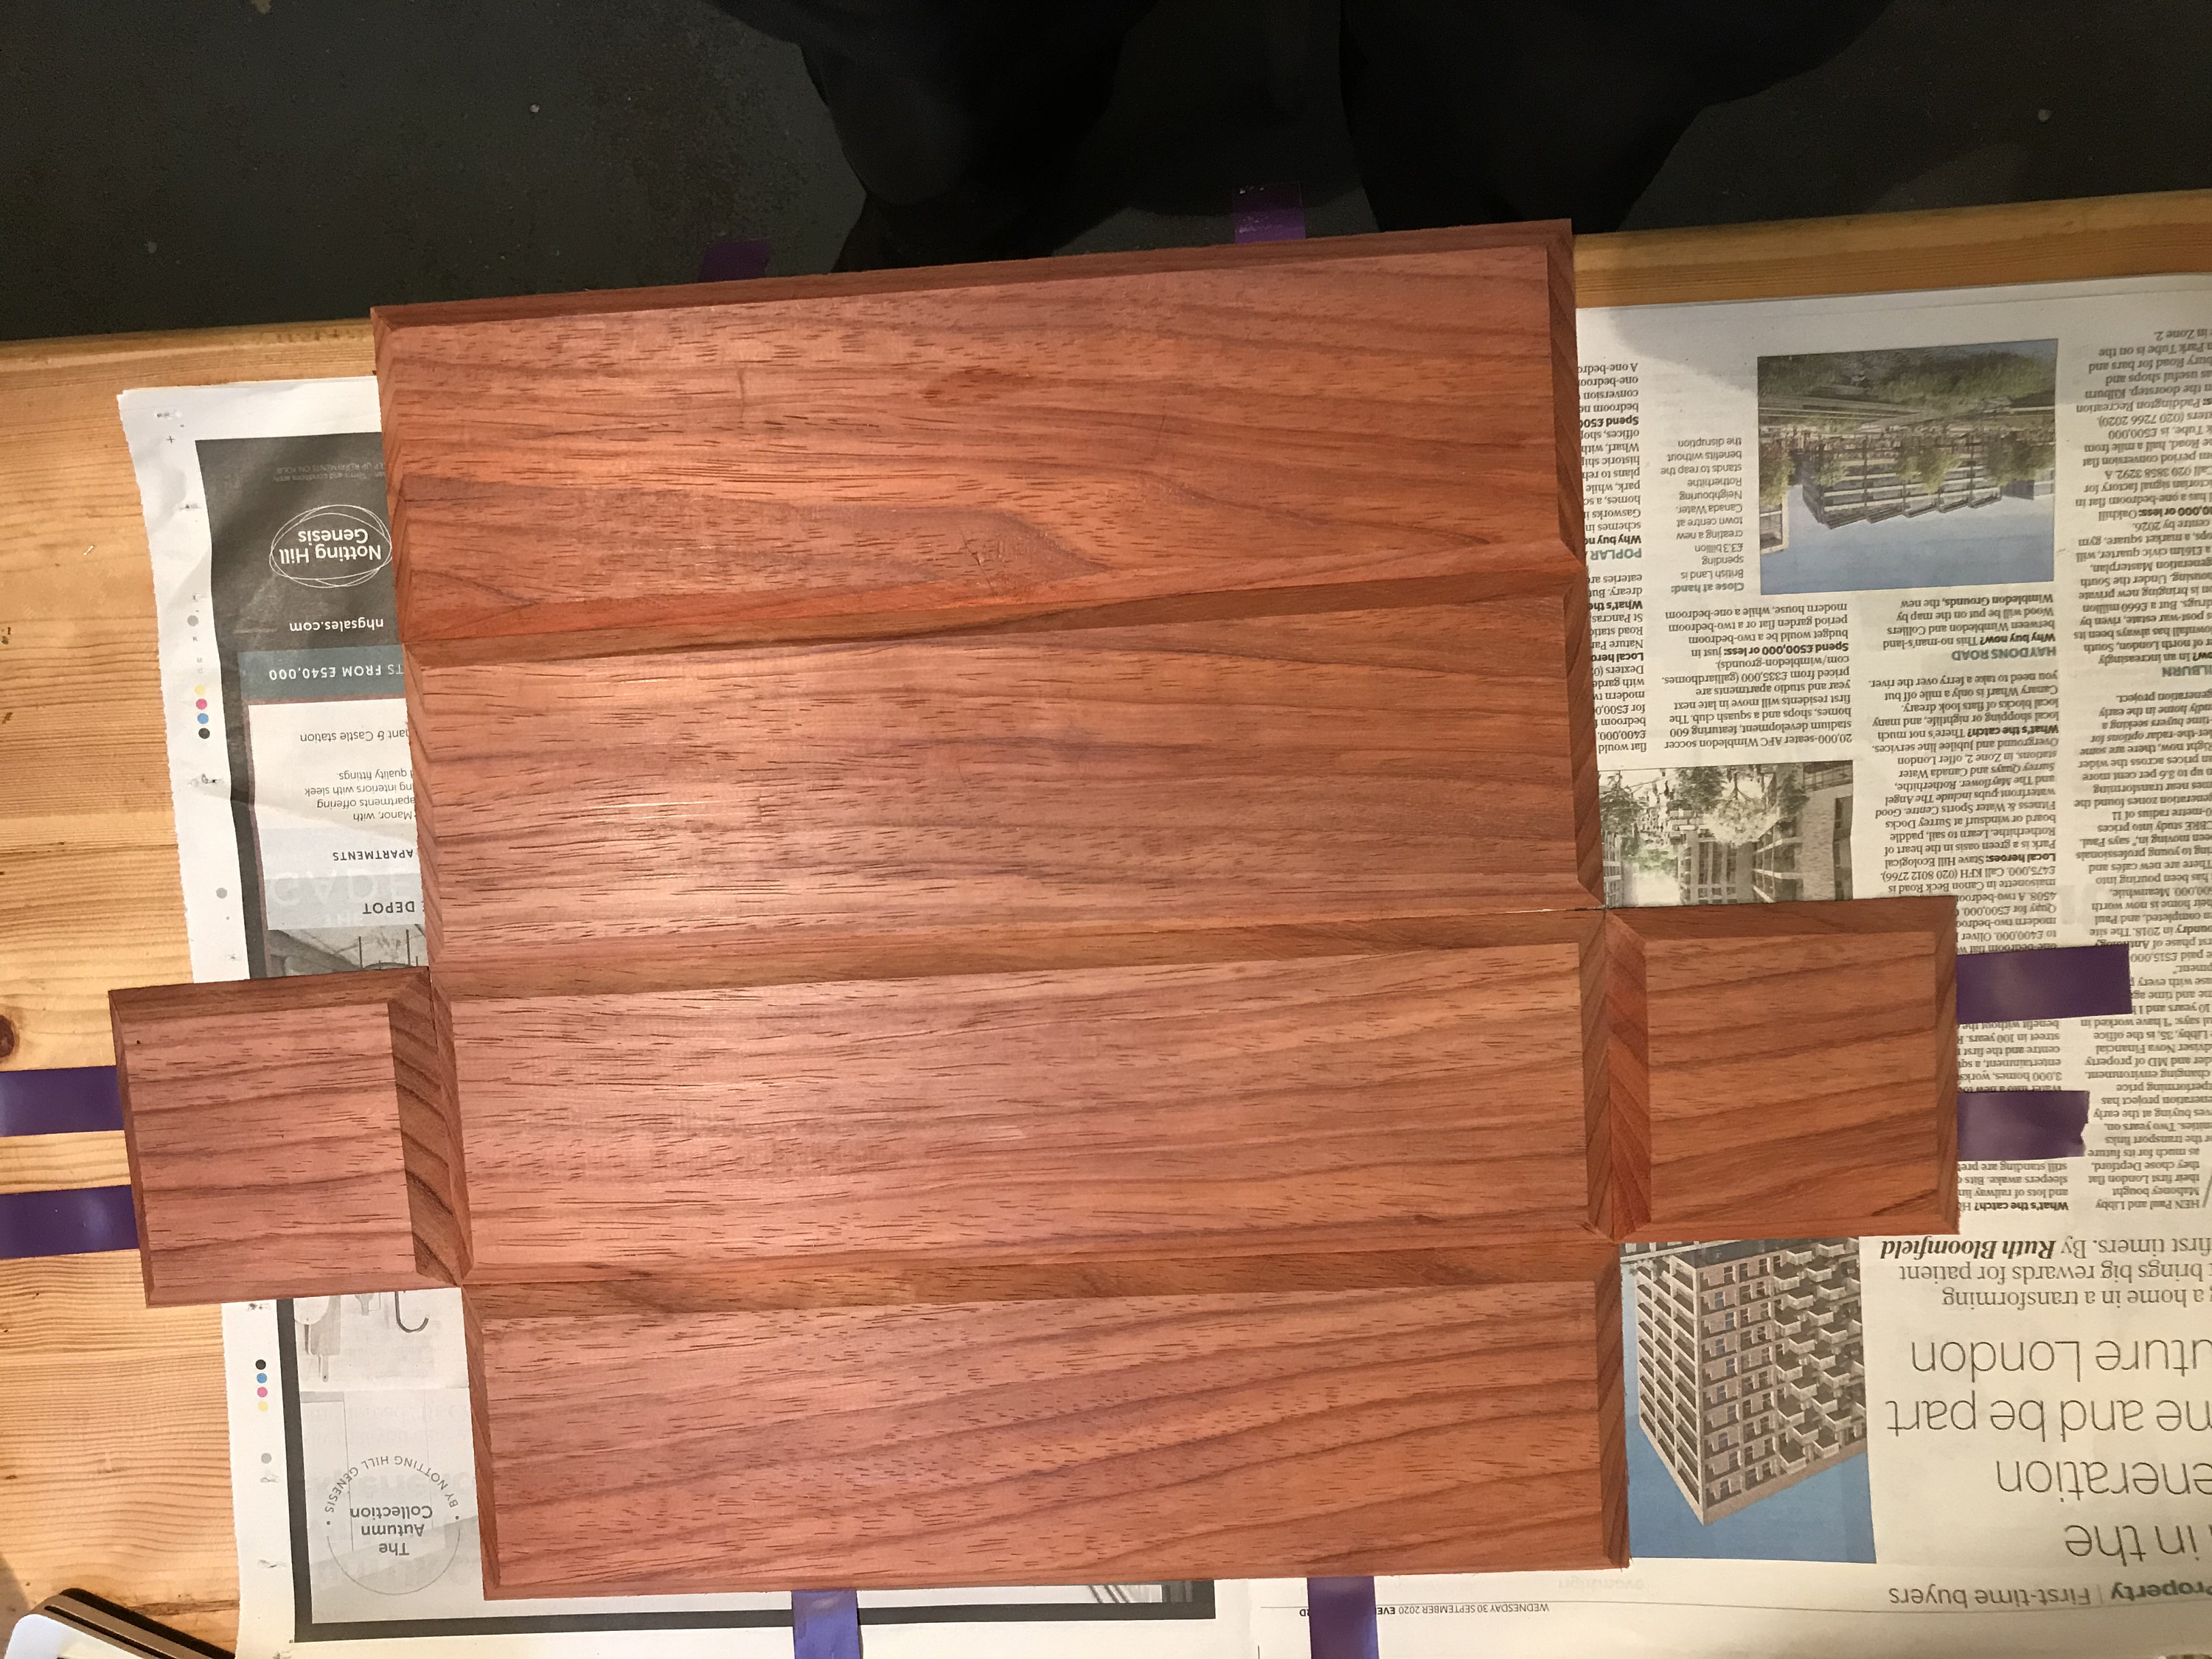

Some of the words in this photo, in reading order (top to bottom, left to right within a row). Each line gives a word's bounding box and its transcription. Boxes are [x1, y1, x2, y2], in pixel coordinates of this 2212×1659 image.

[1677, 438, 1725, 448] disruption
[1667, 453, 1705, 462] without
[1705, 451, 1743, 461] benefits
[1660, 467, 1677, 476] the
[1677, 465, 1700, 473] reap
[1700, 465, 1711, 473] to
[1712, 464, 1742, 473] stands
[1687, 478, 1743, 487] Rotherhithe
[1679, 489, 1743, 501] Neighbouring
[1677, 506, 1708, 514] Water.
[1708, 504, 1743, 513] Canada
[1591, 509, 1641, 520] Gasworks
[1677, 519, 1687, 527] at
[1687, 518, 1718, 526] centre
[298, 529, 369, 546] Genesis
[1618, 534, 1642, 544] Why
[1705, 529, 1744, 539] creating
[1594, 535, 1617, 545] buy
[279, 549, 310, 564] Hill
[315, 543, 382, 563] Notting
[1590, 549, 1643, 560] POPLAR
[1702, 554, 1745, 566] spending
[1690, 571, 1714, 580] Land
[1715, 569, 1745, 578] British
[1671, 585, 1702, 594] hand:
[1703, 584, 1714, 592] at
[1715, 582, 1745, 591] Close
[289, 617, 383, 633] nhgsales.com
[1766, 633, 1779, 642] be
[1780, 632, 1812, 642] would
[1813, 628, 1849, 639] budget
[2009, 633, 2031, 643] buy
[2031, 632, 2056, 642] Why
[1688, 634, 1756, 644] two-bedroom
[1883, 638, 1954, 650] no-man's-land
[1956, 637, 1979, 647] This
[1978, 636, 2008, 645] now?
[1724, 647, 1747, 656] less:
[1761, 644, 1814, 655] £500,000
[1815, 641, 1849, 653] Spend
[1691, 650, 1702, 658] in
[1704, 647, 1722, 658] just
[1951, 650, 1990, 661] ROAD
[1991, 647, 2057, 659] HAYDONS
[268, 666, 336, 681] £540,000
[341, 664, 382, 678] FROM
[1790, 670, 1815, 680] from
[1817, 667, 1850, 679] priced
[1662, 672, 1740, 685] (galliardhomes.
[1741, 672, 1788, 682] £335,000
[1714, 680, 1773, 695] apartments
[1774, 684, 1806, 694] studio
[1808, 683, 1827, 693] and
[1827, 680, 1851, 689] year
[1717, 710, 1752, 723] squash
[1761, 711, 1781, 721] and
[1783, 708, 1813, 719] shops
[1814, 708, 1852, 717] homes,
[1669, 715, 1690, 725] The
[1690, 714, 1715, 724] club.
[1691, 726, 1738, 735] featuring
[1739, 722, 1809, 733] development,
[1810, 721, 1852, 731] stadium
[300, 732, 337, 743] station
[340, 731, 374, 742] Castle
[377, 730, 385, 740] &
[1597, 730, 1646, 741] £400,000.
[1669, 728, 1691, 737] 600
[1698, 738, 1759, 748] Wimbledon
[1760, 737, 1784, 746] AFC
[1784, 734, 1853, 743] 20,000-seater
[1596, 744, 1630, 754] would
[1631, 743, 1647, 752] flat
[1665, 740, 1699, 748] soccer
[336, 769, 372, 782] fittings.
[375, 768, 407, 780] quality
[305, 787, 330, 797] sleek
[333, 786, 354, 796] with
[356, 785, 397, 794] interiors
[317, 797, 357, 810] offering
[359, 796, 415, 807] apartments
[353, 813, 375, 822] with
[378, 810, 412, 820] Manor,
[333, 849, 413, 861] APARTMENTS
[1958, 856, 1985, 864] Stave
[1985, 855, 2026, 863] heroes:
[2026, 853, 2057, 863] Local
[1885, 857, 1936, 869] Ecological
[1938, 857, 1956, 866] Hill
[362, 901, 415, 914] DEPOT
[2088, 1176, 2106, 1185] flat
[2107, 1175, 2150, 1185] London
[2152, 1175, 2174, 1183] first
[2175, 1174, 2200, 1183] their
[2112, 1186, 2151, 1197] bought
[2152, 1186, 2200, 1197] Mahoney
[1975, 1203, 2009, 1211] catch?
[2011, 1203, 2029, 1211] the
[2031, 1202, 2069, 1211] What's
[1881, 1236, 1997, 1259] Bloomfield
[2004, 1240, 2056, 1259] Ruth
[2060, 1235, 2086, 1259] By
[2093, 1239, 2164, 1256] timers.
[2171, 1237, 2212, 1256] first
[1899, 1262, 1972, 1283] patient
[1977, 1265, 2006, 1284] for
[2012, 1265, 2095, 1283] rewards
[2102, 1260, 2132, 1283] big
[2138, 1260, 2202, 1282] brings
[1942, 1288, 2079, 1310] transforming
[2085, 1291, 2096, 1304] a
[2103, 1290, 2121, 1308] in
[2127, 1289, 2187, 1307] home
[2192, 1290, 2204, 1303] a
[1912, 1340, 2080, 1383] London
[1885, 1390, 1975, 1437] part
[1991, 1400, 2045, 1442] be
[2060, 1400, 2144, 1442] and
[361, 1455, 389, 1470] HILL
[393, 1454, 448, 1491] NOTTING
[324, 1465, 359, 1514] GENESIS
[444, 1490, 460, 1509] BY
[349, 1506, 433, 1520] Collection
[361, 1523, 425, 1539] Autumn
[2065, 1525, 2146, 1567] the
[2154, 1525, 2199, 1562] in
[378, 1543, 410, 1557] The
[1888, 1584, 1967, 1609] buyers
[1975, 1587, 2090, 1607] First-time
[1377, 1606, 1396, 1615] EVE
[1399, 1605, 1420, 1615] 2020
[1421, 1604, 1475, 1615] SEPTEMBER
[1477, 1604, 1488, 1614] 30
[1489, 1602, 1550, 1613] WEDNESDAY
